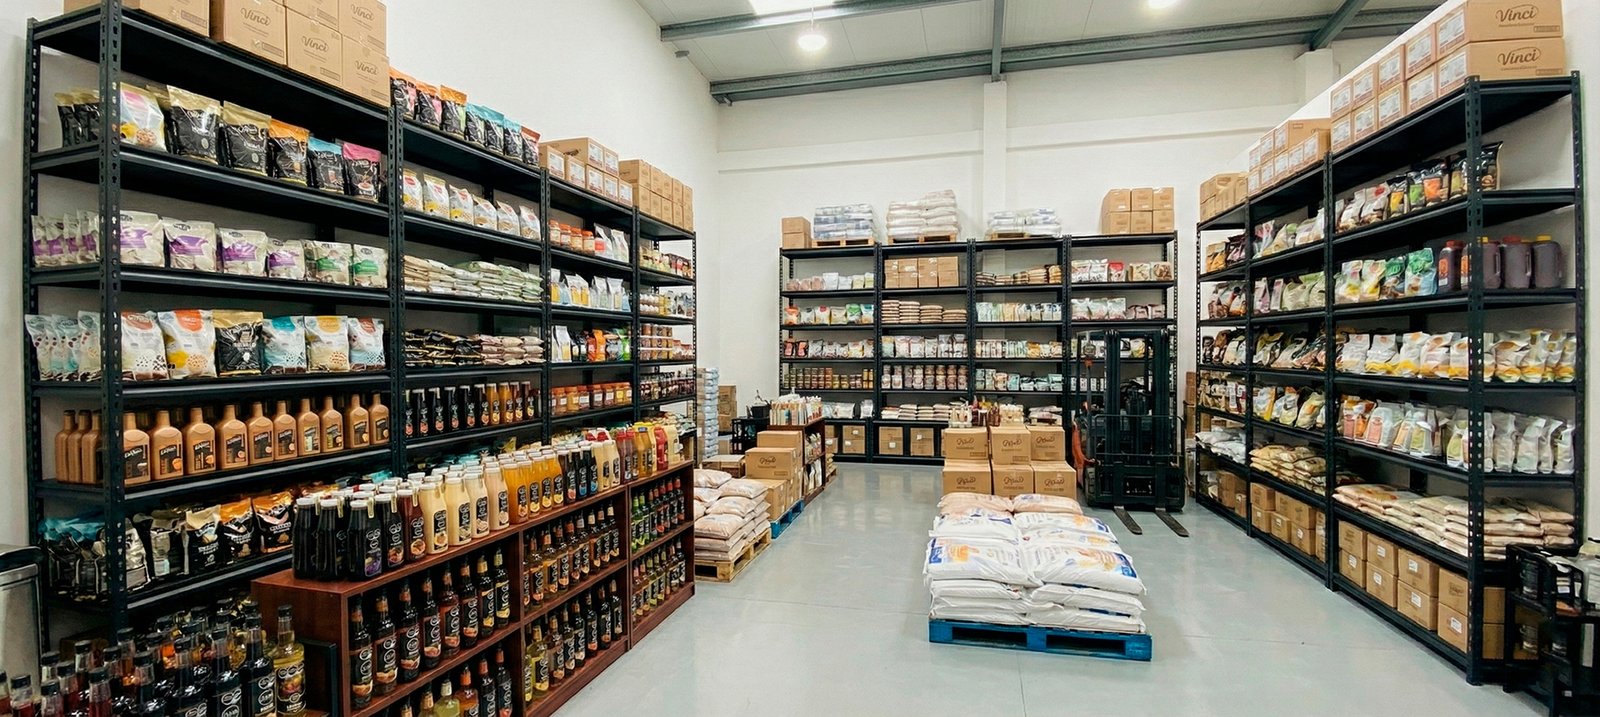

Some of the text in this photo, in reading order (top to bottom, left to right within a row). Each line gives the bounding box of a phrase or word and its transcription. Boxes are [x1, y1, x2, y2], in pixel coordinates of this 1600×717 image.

[240, 8, 271, 26] Vinci
[351, 4, 374, 21] Vinci
[1495, 4, 1538, 22] Vinci
[301, 35, 329, 53] Vinci
[1498, 46, 1541, 66] Vinci
[354, 60, 379, 76] Vinci
